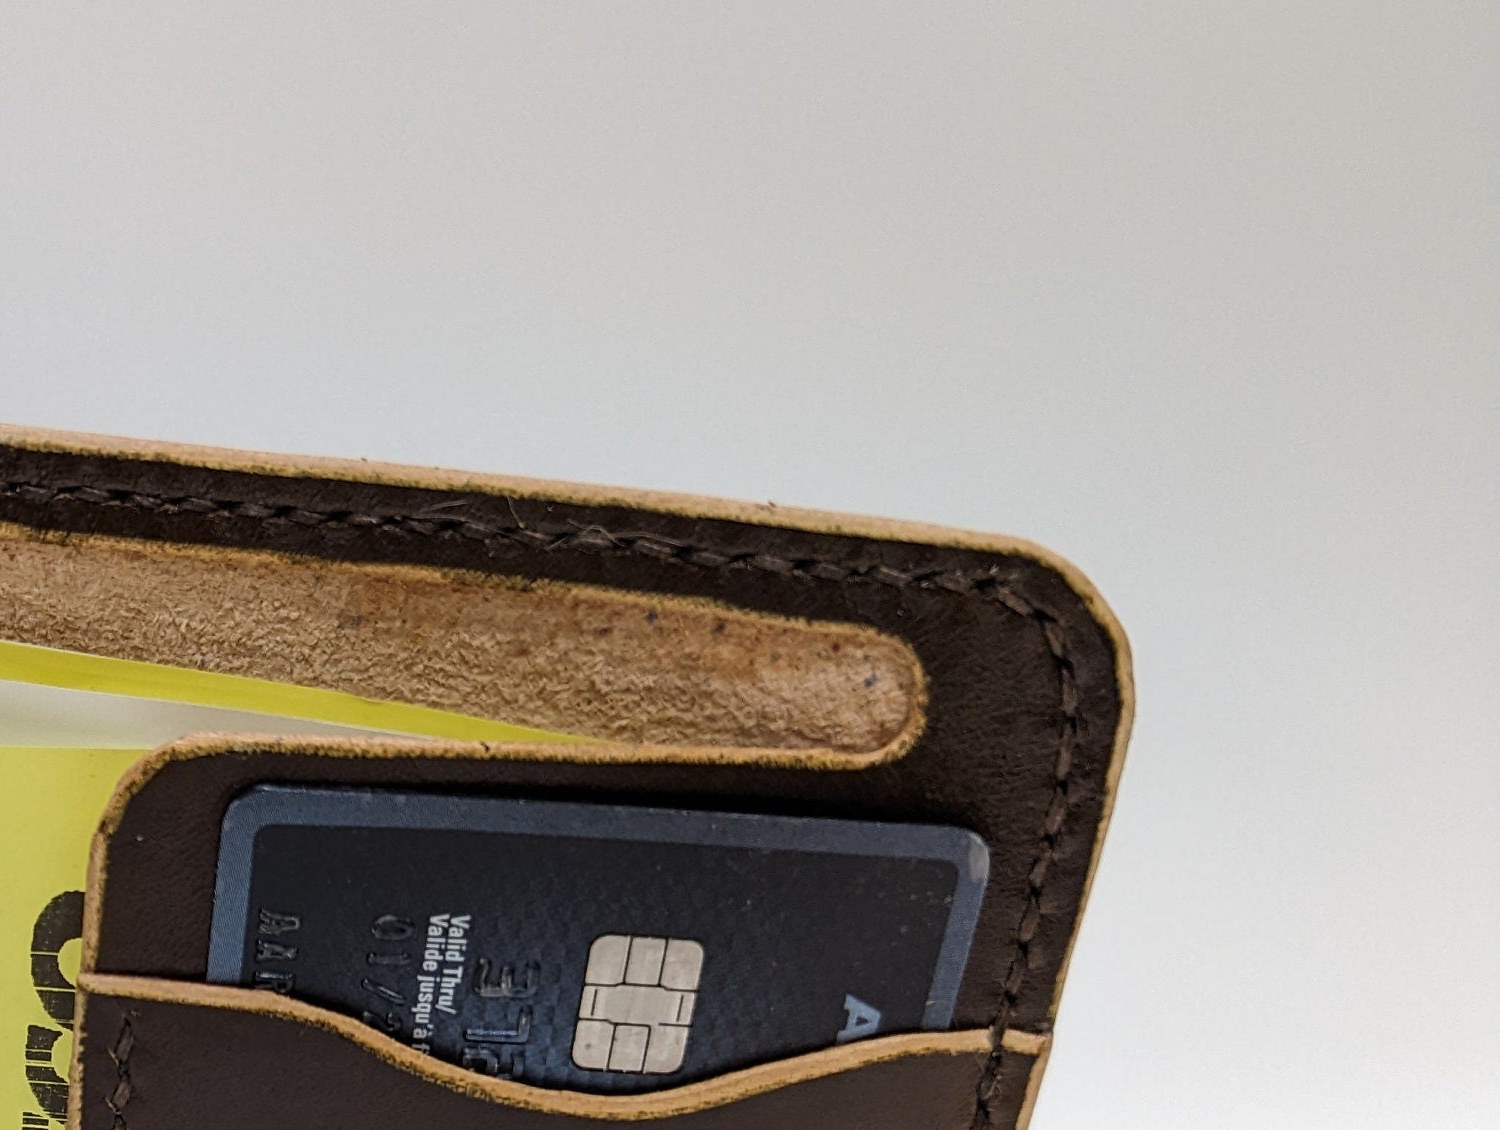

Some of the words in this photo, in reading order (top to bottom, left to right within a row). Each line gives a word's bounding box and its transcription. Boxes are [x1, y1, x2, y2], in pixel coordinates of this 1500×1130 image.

[422, 913, 451, 971] Valide
[444, 913, 472, 962] Valid
[435, 965, 464, 1015] Thru/
